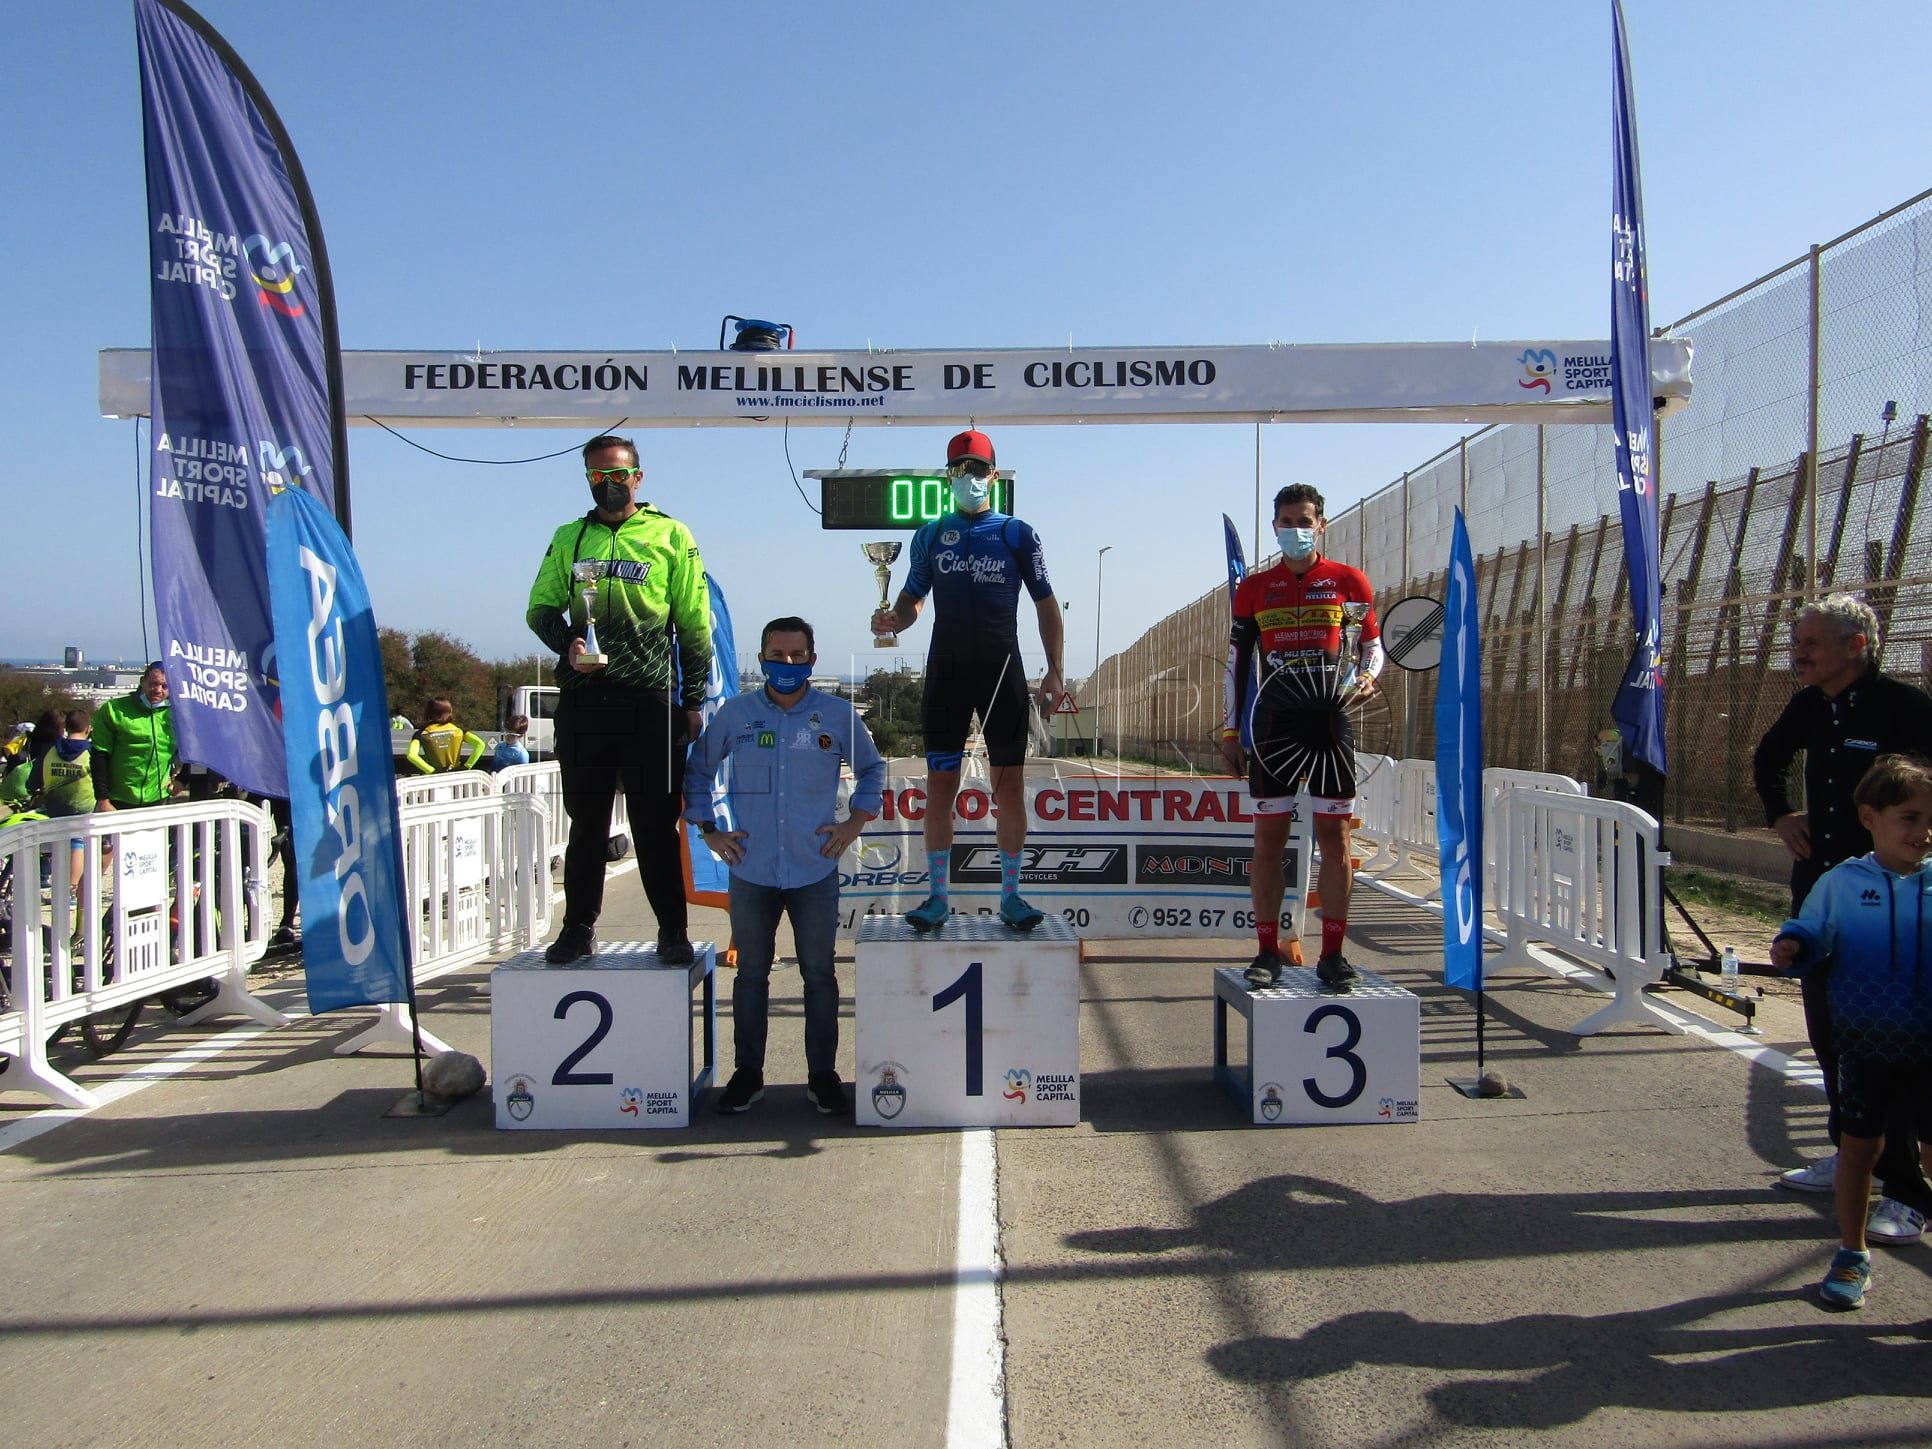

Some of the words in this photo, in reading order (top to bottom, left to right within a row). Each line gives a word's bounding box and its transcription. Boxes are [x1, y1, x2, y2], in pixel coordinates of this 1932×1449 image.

[404, 359, 648, 391] FEDERACIÓN
[678, 365, 915, 392] MELILLENSE
[943, 364, 996, 389] DE
[1023, 360, 1216, 388] CICLISMO
[1565, 368, 1609, 378] SPORT
[1567, 379, 1612, 389] CAPITA
[736, 396, 886, 409] www.fmciclismo.net
[935, 550, 1006, 574] Ciclotur
[1034, 789, 1254, 822] CENTRAL
[1153, 908, 1192, 927] 952
[1199, 909, 1225, 928] 67
[932, 962, 984, 1096] 1
[551, 990, 615, 1086] 2
[1302, 1004, 1369, 1109] 3
[1036, 1075, 1075, 1083] MELILLA
[1036, 1084, 1068, 1092] SPORT
[646, 1092, 678, 1100] MELILLA
[1036, 1092, 1076, 1101] CAPITAL
[646, 1099, 672, 1107] SPORT
[646, 1107, 678, 1115] CAPITAL
